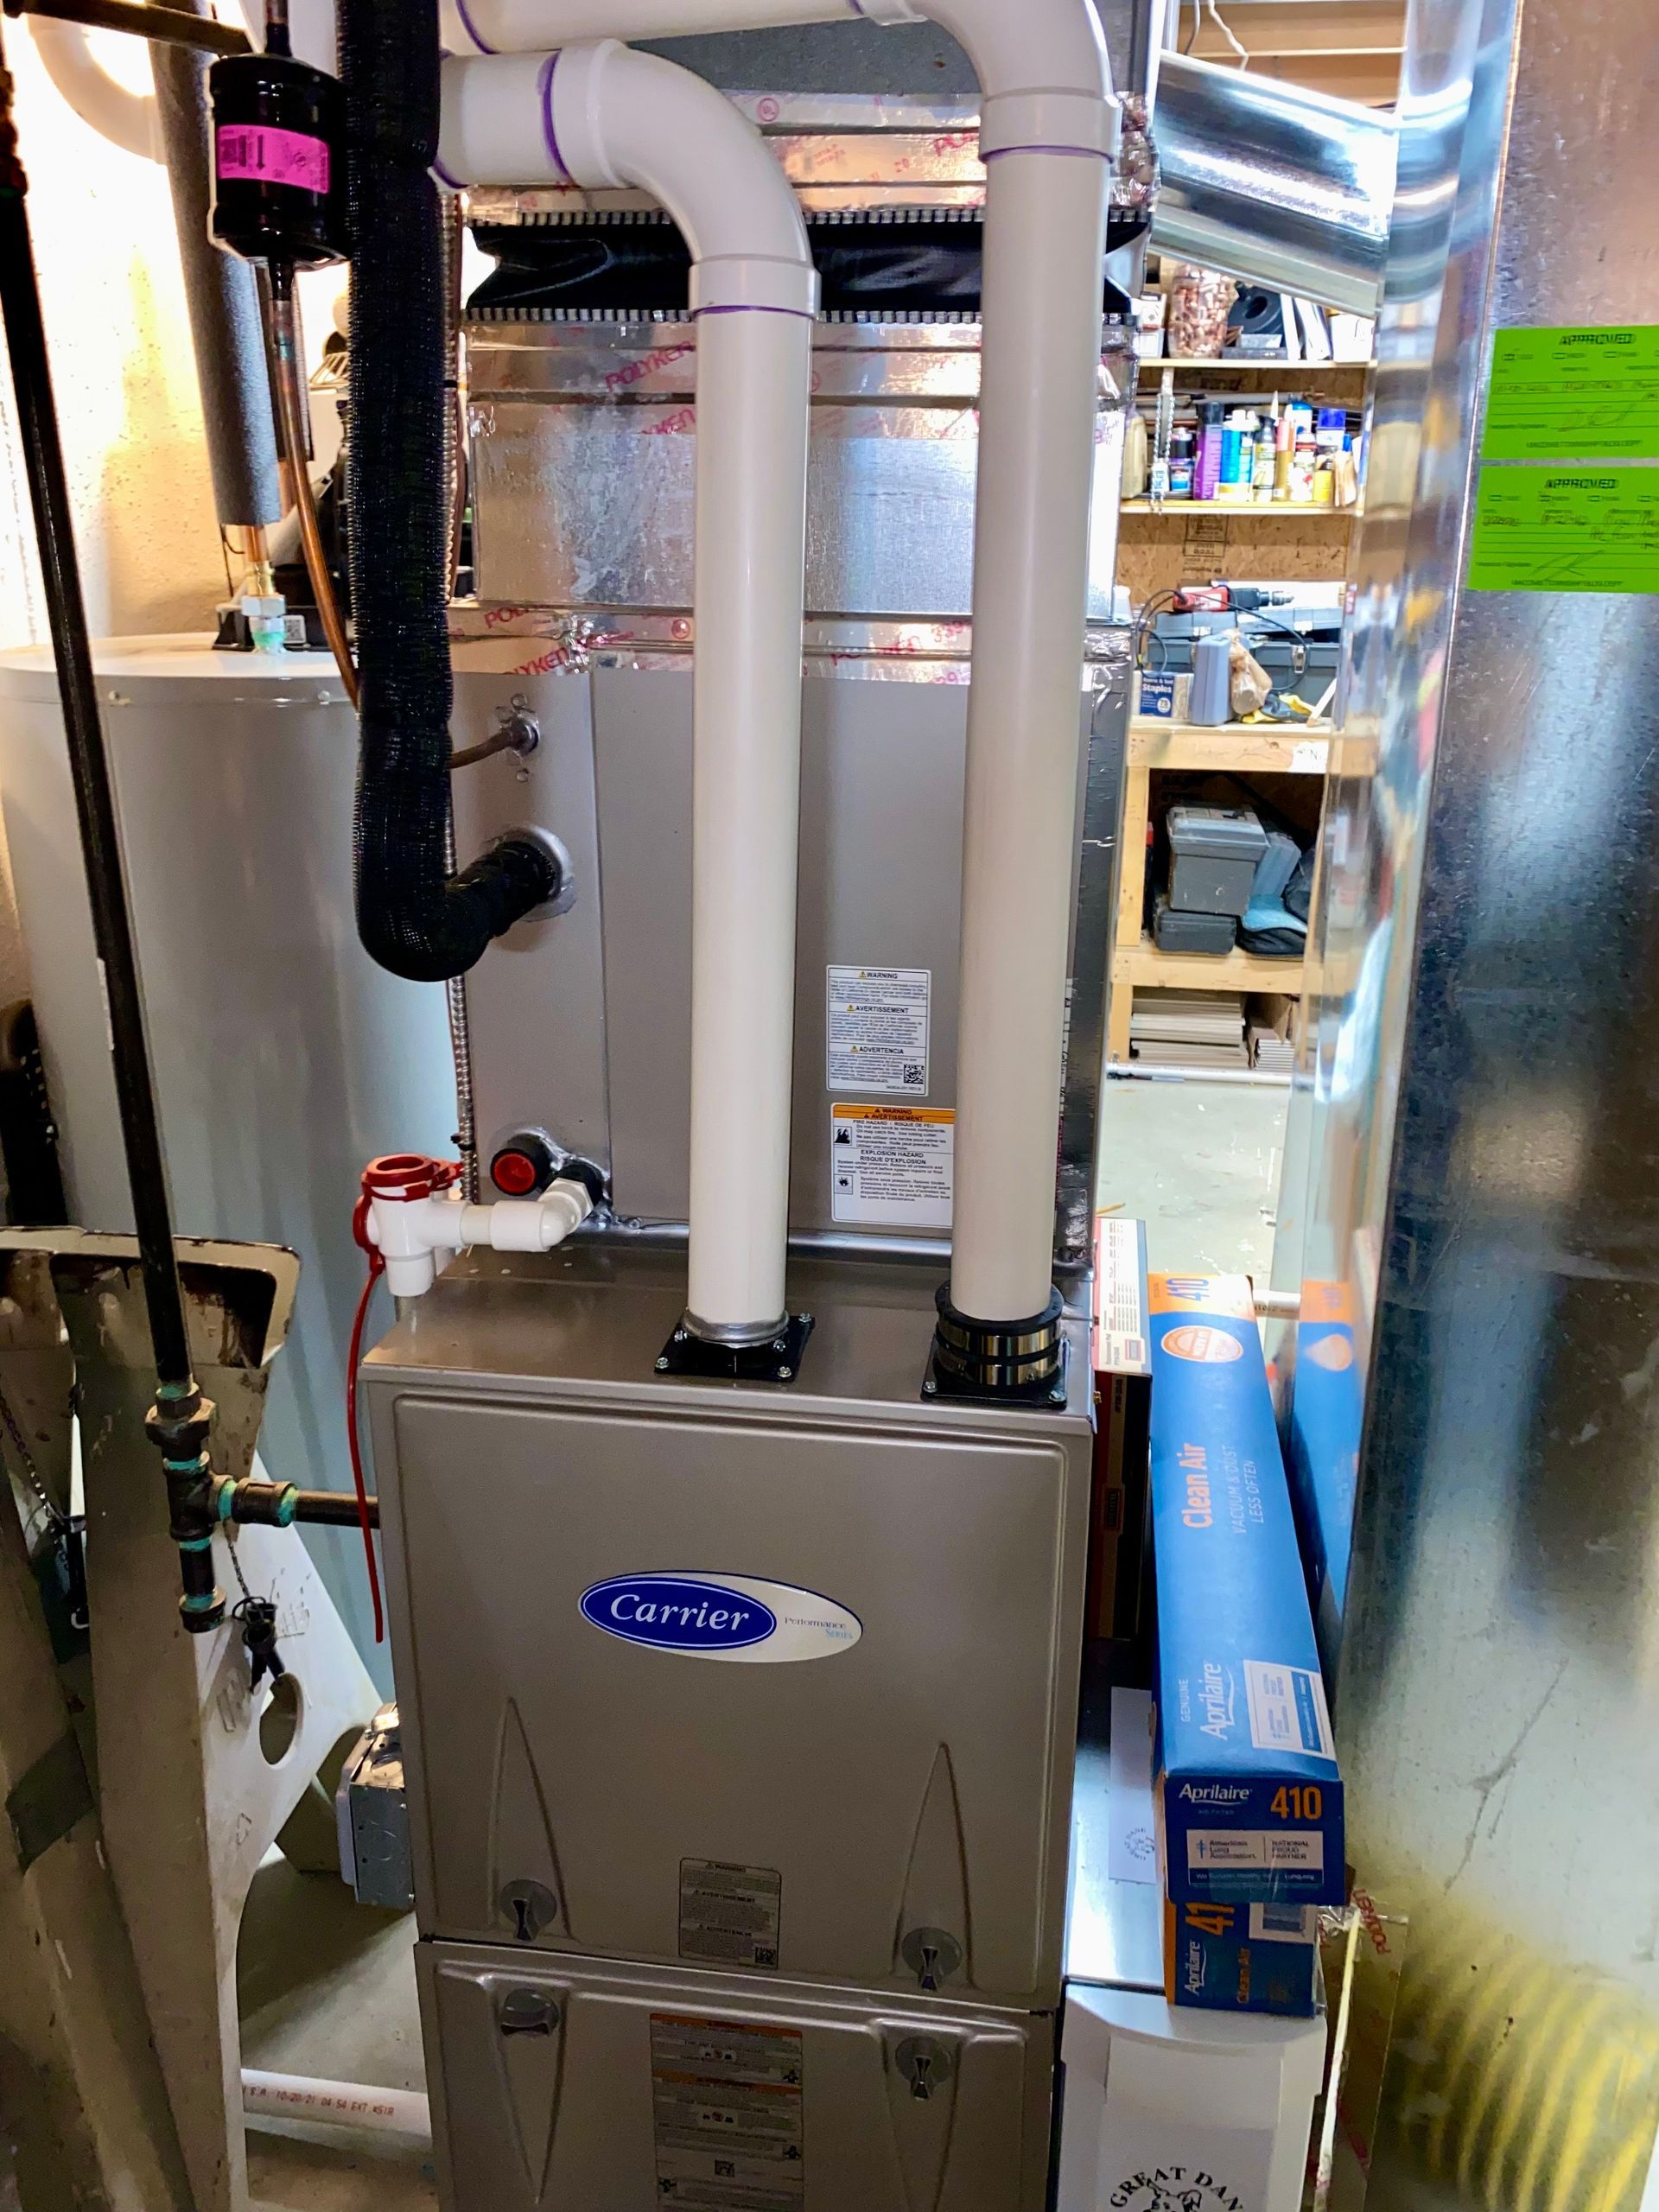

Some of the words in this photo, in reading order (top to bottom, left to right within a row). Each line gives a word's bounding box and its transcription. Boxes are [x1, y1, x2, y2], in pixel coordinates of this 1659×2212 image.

[1560, 334, 1636, 346] APPROVED
[1544, 479, 1619, 489] APPROVED
[1142, 683, 1173, 694] Staples
[855, 1005, 909, 1014] AVERTISSEMENT
[1166, 1278, 1210, 1301] 410
[1176, 1442, 1207, 1471] Air
[1221, 1444, 1239, 1475] DUST
[1243, 1460, 1259, 1494] OFTEN
[1181, 1474, 1213, 1528] Clean
[1227, 1485, 1247, 1534] VACUUM
[1248, 1496, 1264, 1523] LESS
[610, 1593, 749, 1630] Carrier
[785, 1616, 846, 1630] Performance
[1179, 1678, 1191, 1722] GENUINE
[1198, 1663, 1230, 1741] Aprilaire
[1179, 1783, 1251, 1804] Aprilaire
[1270, 1786, 1322, 1820] 410
[1185, 1939, 1204, 1995] Aprilaire
[1239, 1948, 1251, 1967] Air
[1236, 1970, 1250, 2005] Clean
[1110, 2166, 1187, 2208] GREAT
